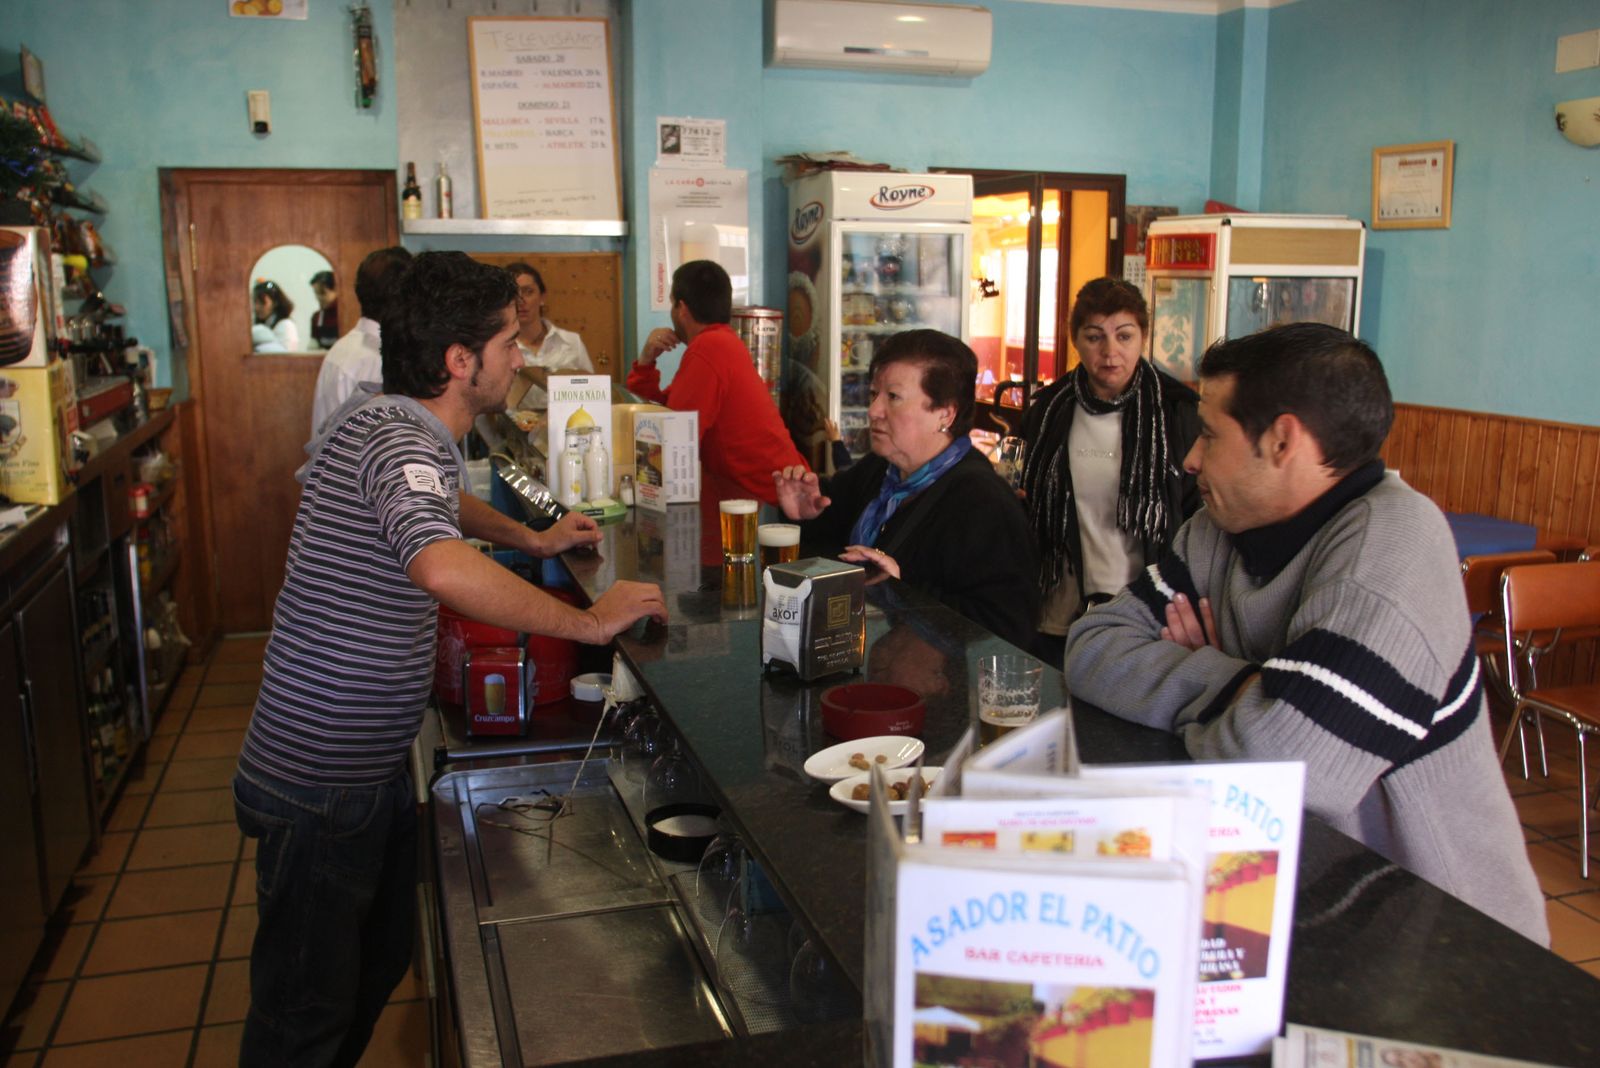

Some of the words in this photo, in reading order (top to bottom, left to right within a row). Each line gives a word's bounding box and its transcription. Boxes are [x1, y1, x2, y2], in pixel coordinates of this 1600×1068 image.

[540, 69, 582, 77] VALENCIA
[879, 185, 926, 203] Royne
[772, 607, 799, 620] axor
[1223, 783, 1284, 843] PATIO
[910, 890, 1028, 967] ASADOR
[1038, 891, 1072, 927] EL
[1080, 901, 1162, 980] PATIO
[965, 946, 1002, 963] BAR
[1006, 950, 1106, 968] CAFETERIA
